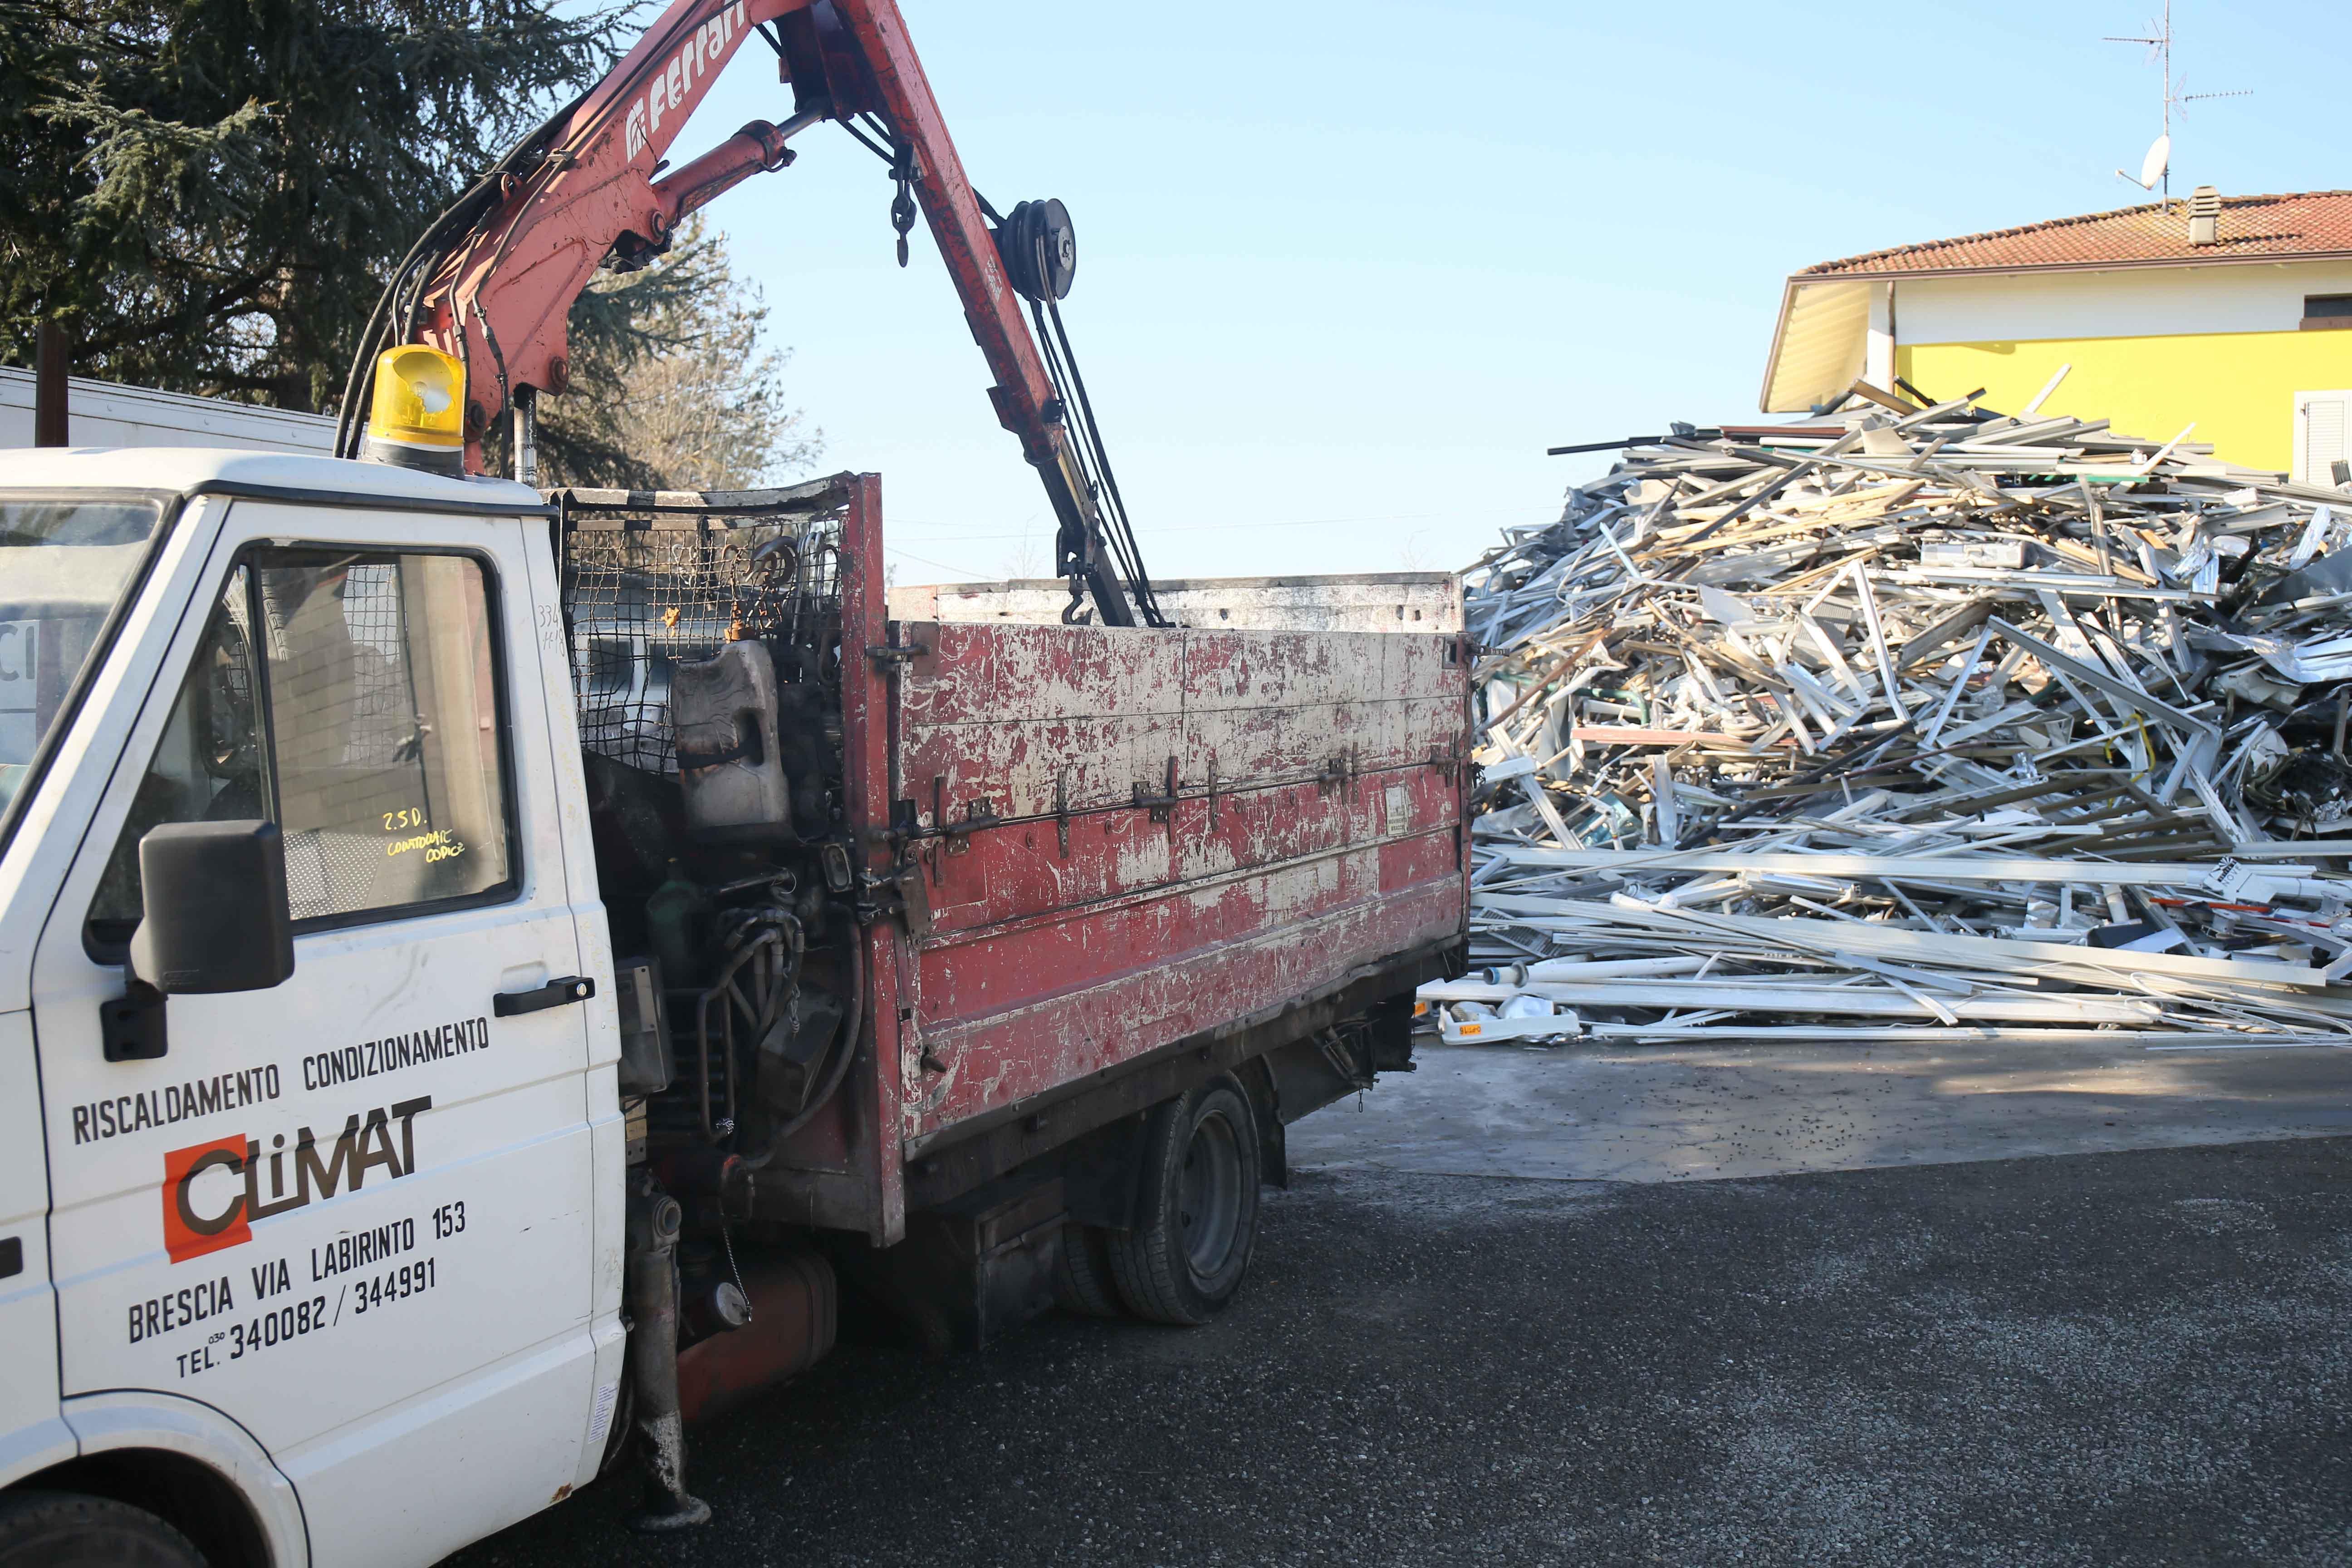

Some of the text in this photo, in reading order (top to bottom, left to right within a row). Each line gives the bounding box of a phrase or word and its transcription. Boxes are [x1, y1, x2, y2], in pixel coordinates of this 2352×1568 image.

[73, 1017, 489, 1145] RISCALDAMENTO CONDIZIONAMENTO
[129, 1201, 466, 1344] BRESCIA VIA LABIRINTO 153
[177, 1346, 220, 1378] TEL.
[230, 1295, 326, 1359] 340082
[355, 1257, 436, 1314] 344991
